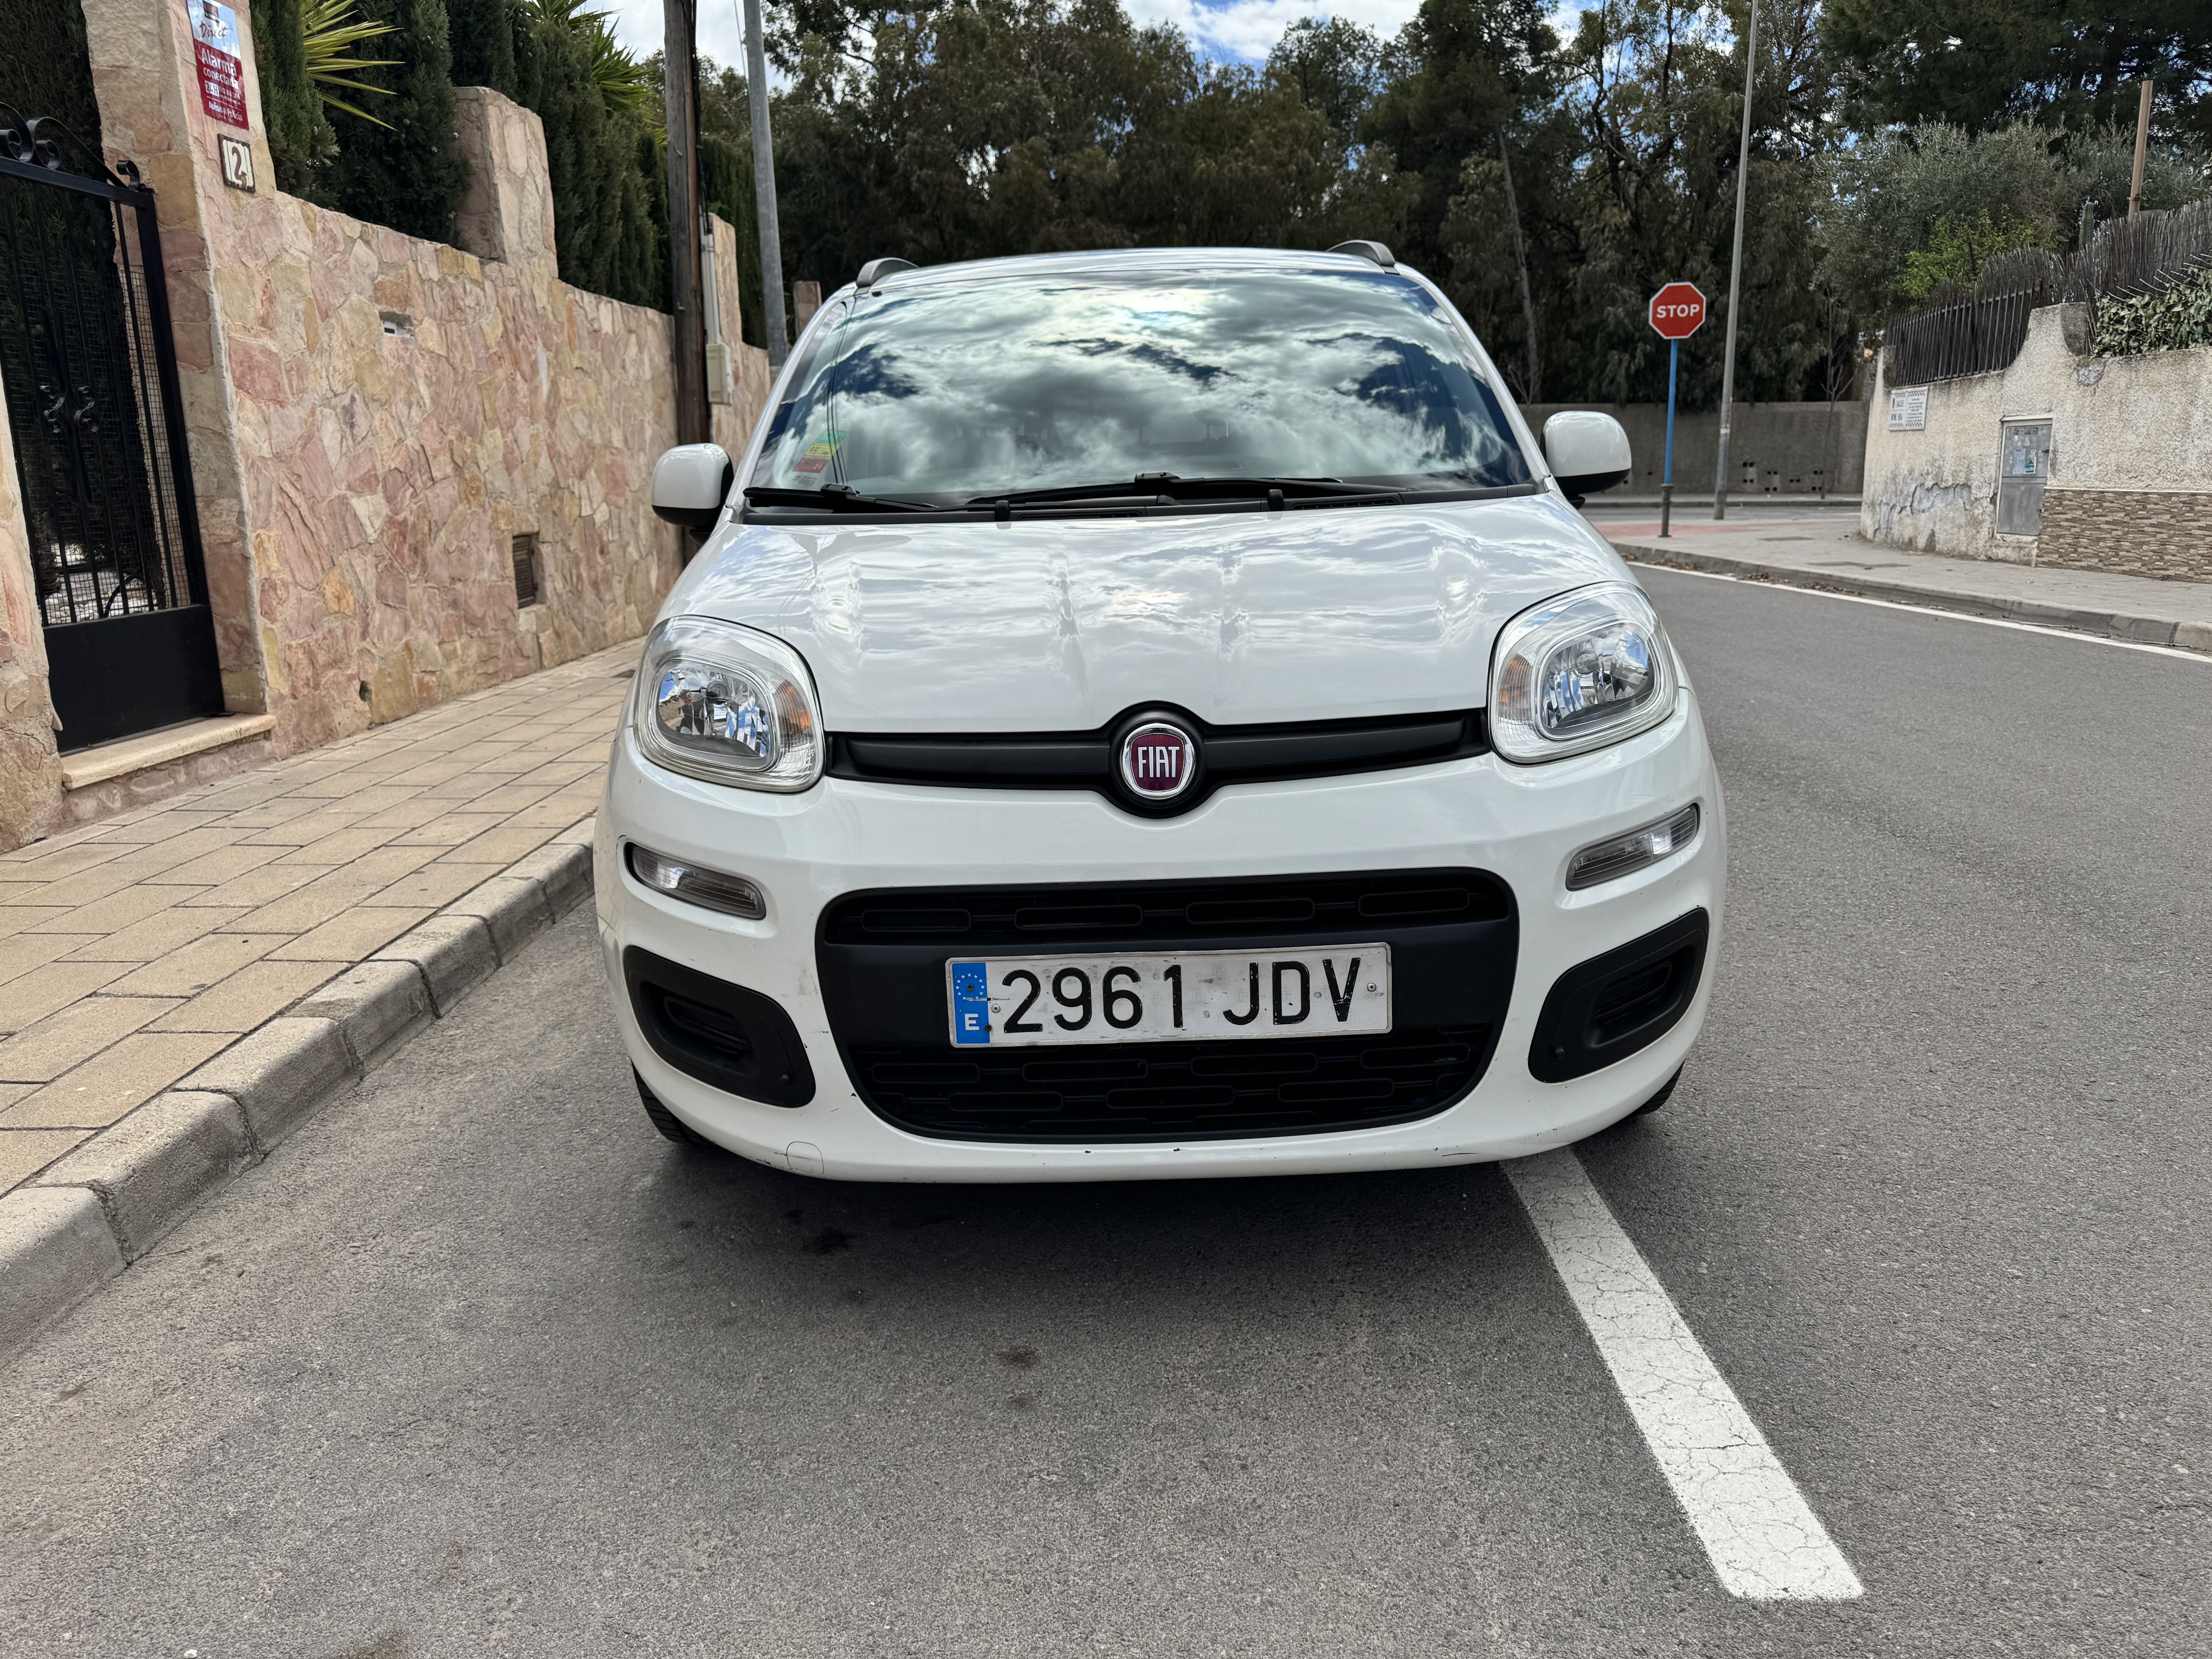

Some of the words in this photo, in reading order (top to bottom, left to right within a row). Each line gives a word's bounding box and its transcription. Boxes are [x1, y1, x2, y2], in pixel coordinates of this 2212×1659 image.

[199, 21, 229, 38] Direct
[202, 48, 237, 77] Alarma
[203, 67, 239, 89] conectada
[206, 82, 218, 95] 24H
[209, 101, 223, 113] Aviso
[227, 108, 243, 121] Policía
[232, 146, 247, 180] 2
[1656, 304, 1700, 318] STOP
[1138, 746, 1180, 778] FIAT
[1002, 964, 1183, 1034] 2961
[1223, 957, 1361, 1025] JDV
[964, 1013, 979, 1030] E
